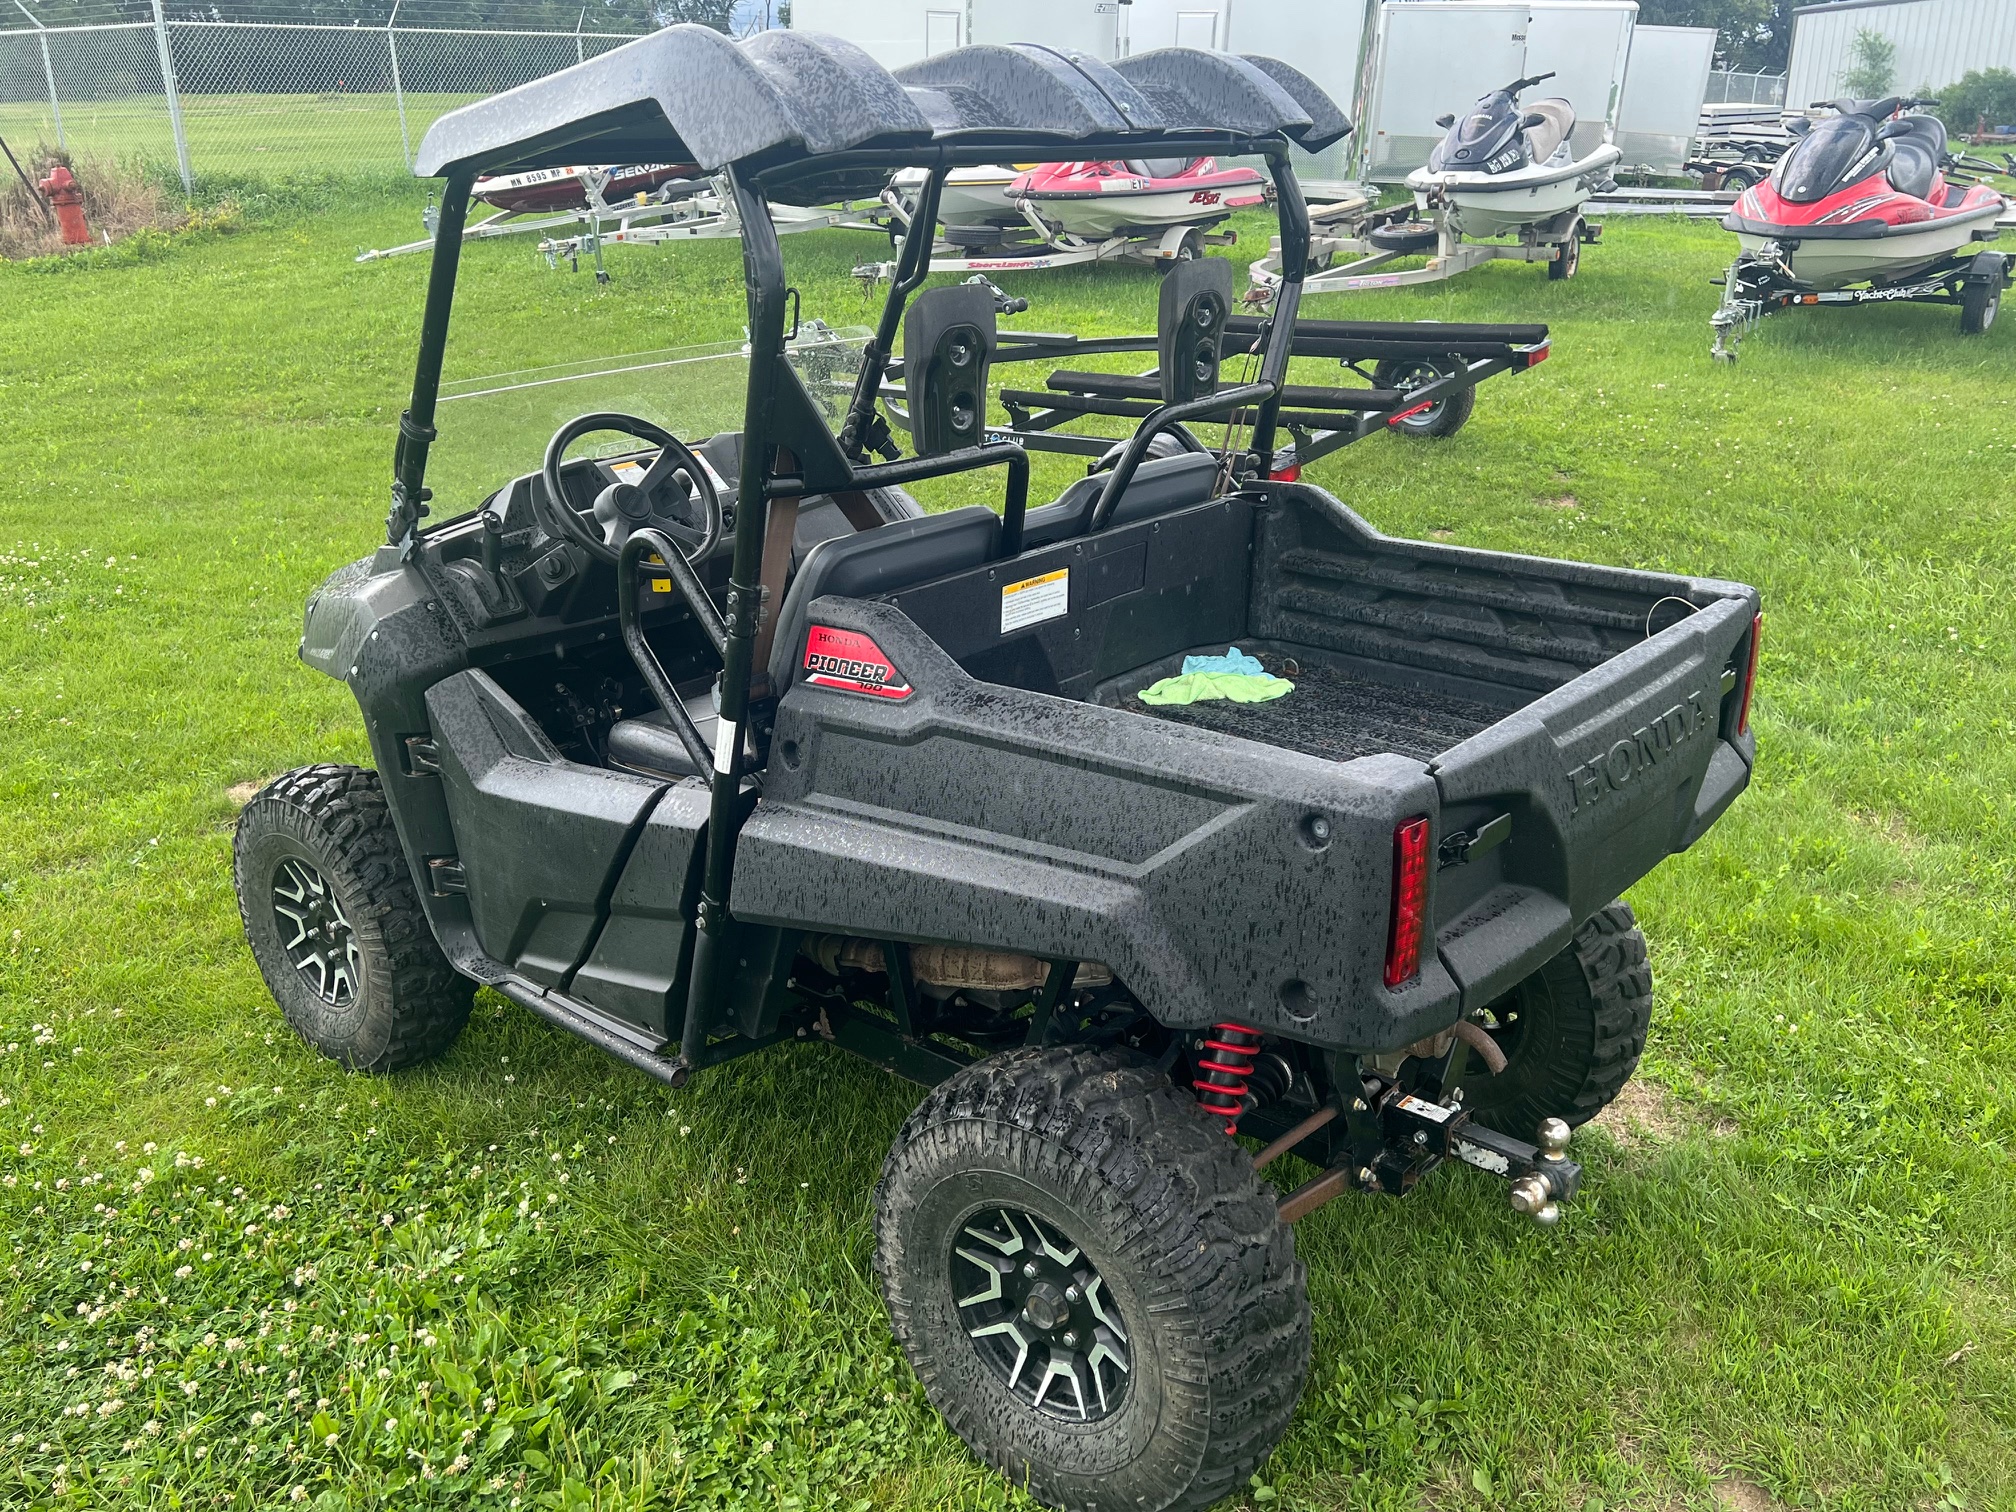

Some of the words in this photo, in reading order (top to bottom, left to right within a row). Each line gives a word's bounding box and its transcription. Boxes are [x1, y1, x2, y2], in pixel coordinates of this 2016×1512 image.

[510, 177, 522, 187] MN
[526, 172, 548, 183] 8595
[1025, 577, 1046, 587] WARNING
[818, 633, 861, 648] HONDA
[807, 653, 888, 683] PIONEER
[856, 681, 884, 692] 700
[1566, 690, 1714, 815] HONDA
